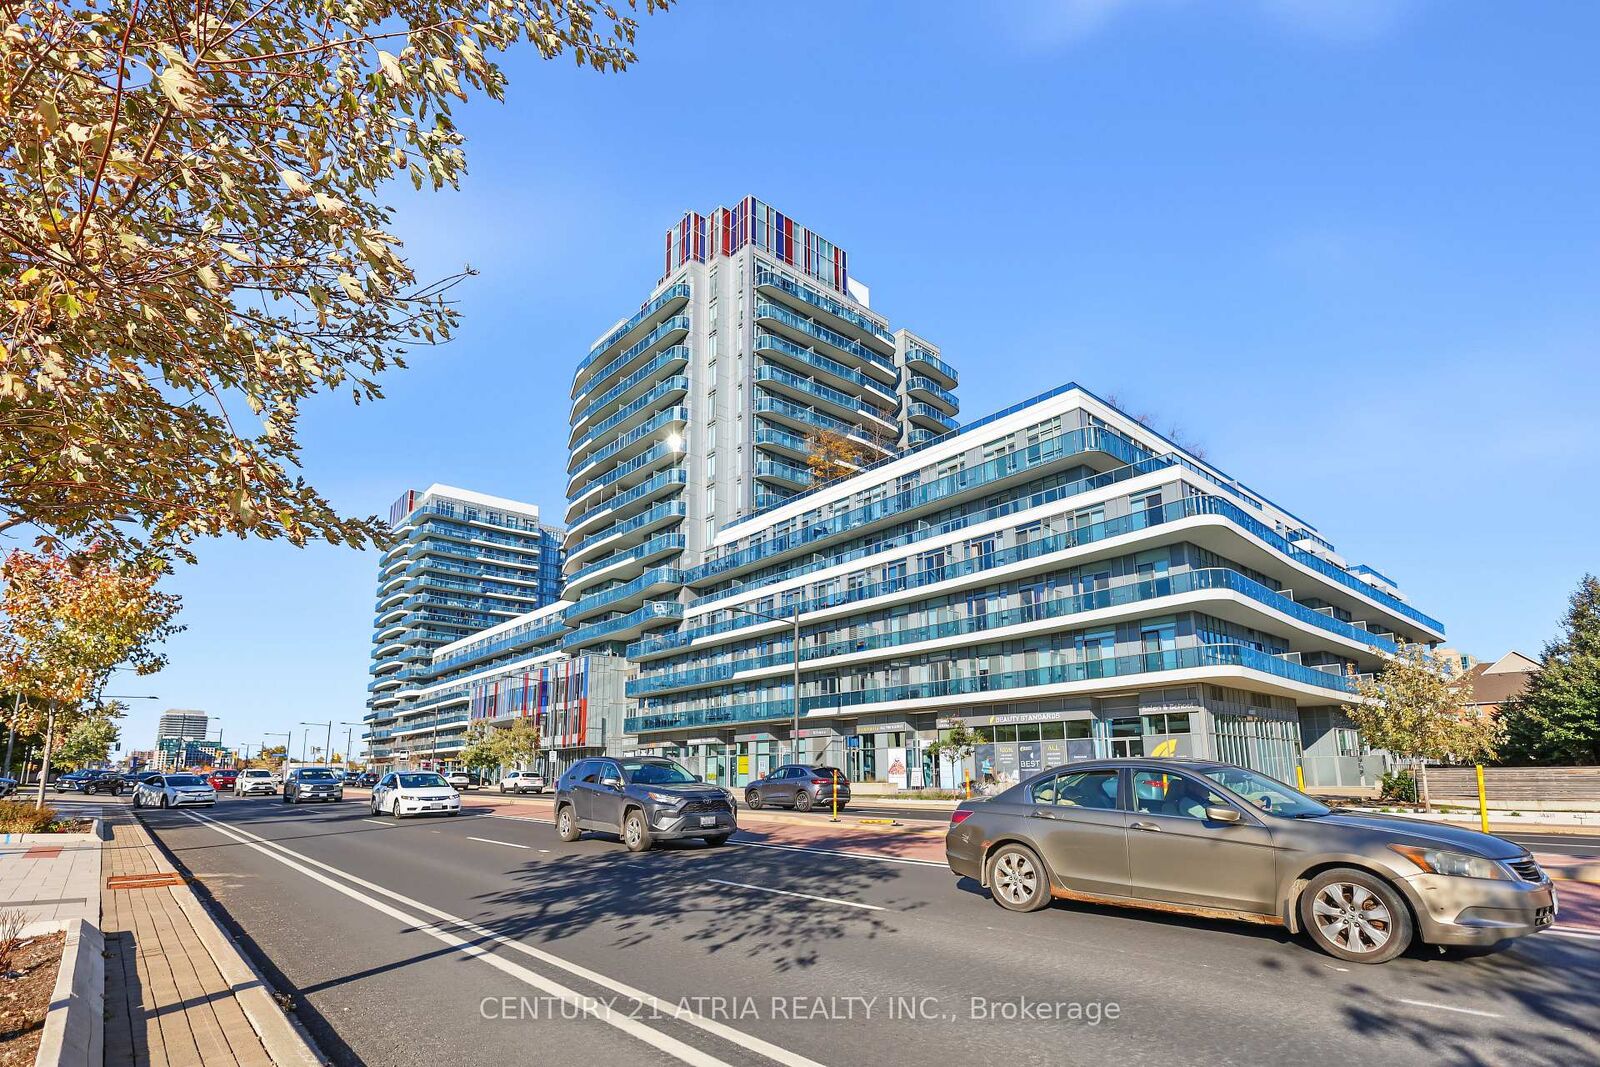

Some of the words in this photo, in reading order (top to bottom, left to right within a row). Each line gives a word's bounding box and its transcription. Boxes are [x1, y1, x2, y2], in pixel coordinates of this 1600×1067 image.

[995, 715, 1019, 723] BEAUTY
[1020, 713, 1061, 722] STANDARDS
[1020, 760, 1040, 768] BEST
